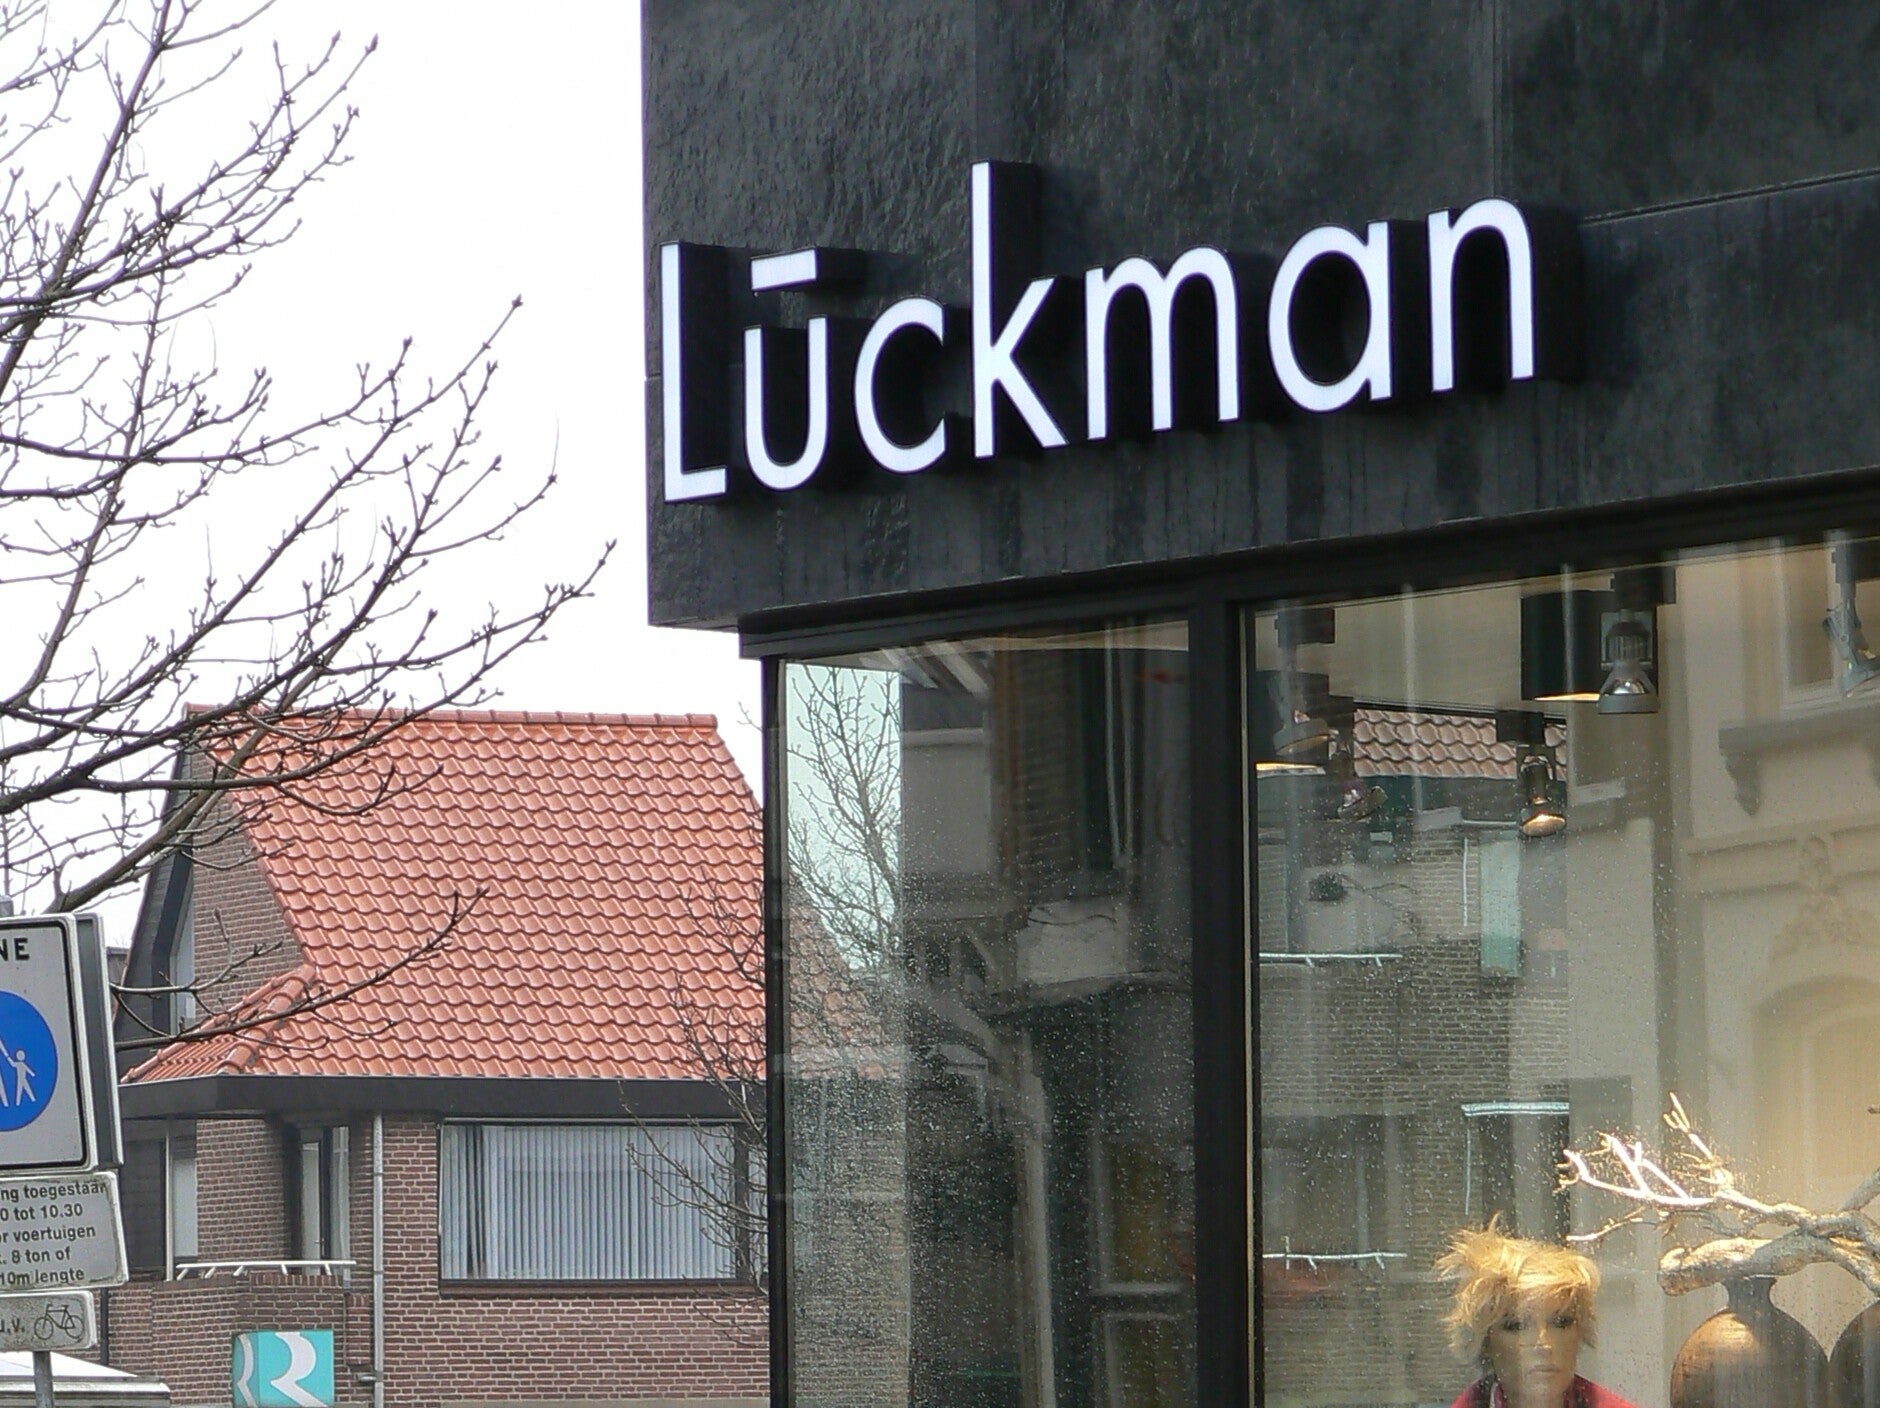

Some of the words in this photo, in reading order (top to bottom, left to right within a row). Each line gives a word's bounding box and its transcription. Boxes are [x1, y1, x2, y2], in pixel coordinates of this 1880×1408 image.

[23, 1181, 107, 1201] toegestaan
[14, 1205, 35, 1221] tot
[41, 1203, 84, 1219] 10.30
[13, 1225, 97, 1243] voertuigen
[11, 1249, 20, 1264] 8
[25, 1248, 51, 1264] ton
[55, 1246, 71, 1262] of
[34, 1268, 85, 1286] lengte
